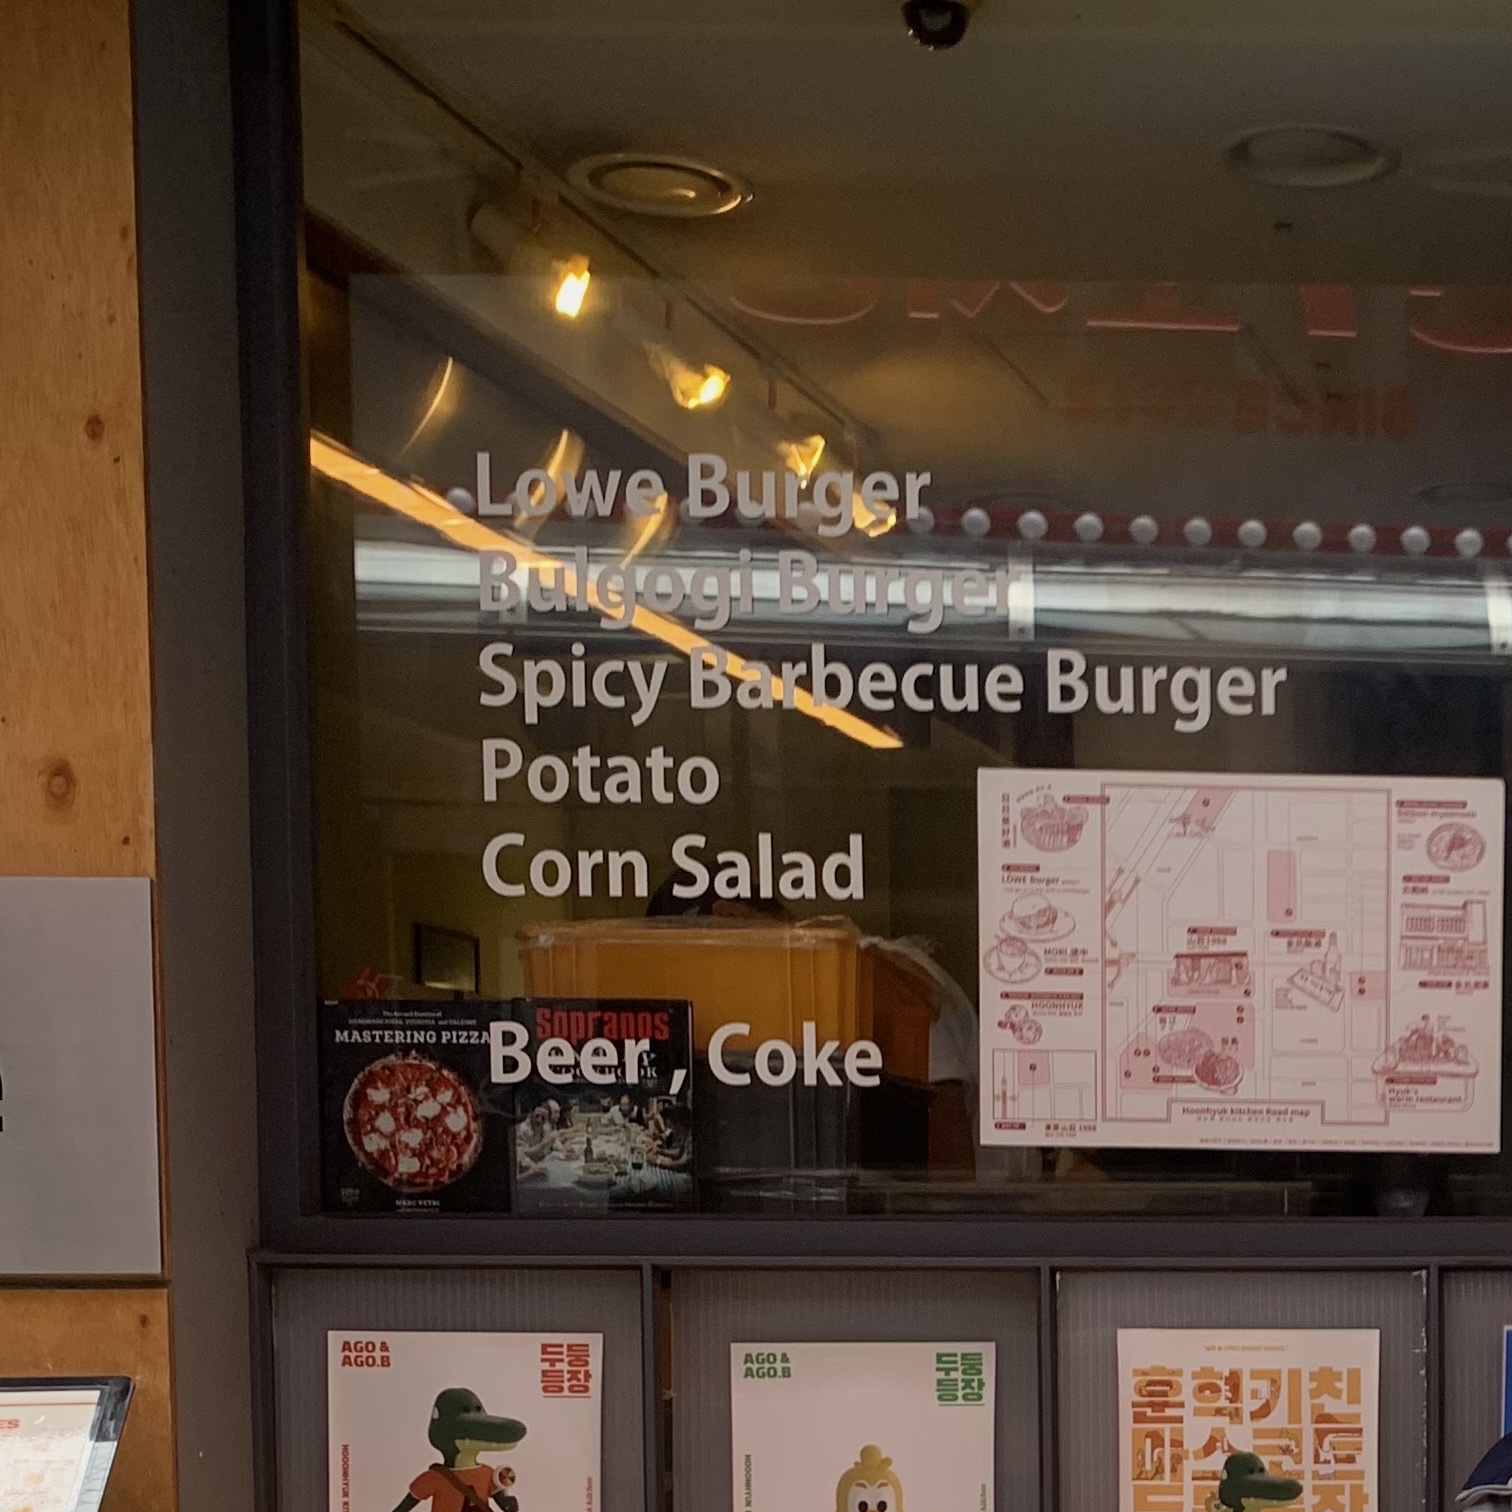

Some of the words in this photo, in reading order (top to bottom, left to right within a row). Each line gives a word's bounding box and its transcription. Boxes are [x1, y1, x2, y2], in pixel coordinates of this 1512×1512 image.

[477, 451, 662, 518] Lowe
[687, 453, 931, 536] Burger
[479, 545, 753, 631] Bulgogi
[778, 550, 1018, 633] Burger
[479, 642, 666, 726] Spicy
[690, 642, 1024, 713] Barbecue
[1047, 648, 1288, 733] Burger
[482, 738, 719, 804] Potato
[482, 833, 648, 898] Corn
[671, 832, 865, 901] Salad
[335, 1029, 437, 1044] MASTERING
[441, 1030, 491, 1044] PIZZA
[535, 1008, 669, 1046] Sopranos
[708, 1021, 883, 1088] Coke
[1182, 1106, 1228, 1118] Hoonhyuk
[1230, 1106, 1264, 1117] kitchen
[1266, 1107, 1288, 1117] Road
[1290, 1109, 1310, 1119] map
[341, 1341, 376, 1353] AGO
[379, 1341, 390, 1352] &
[341, 1355, 391, 1368] AGO.B
[743, 1352, 777, 1365] AGO
[780, 1352, 790, 1364] &
[743, 1366, 791, 1379] AGO.B
